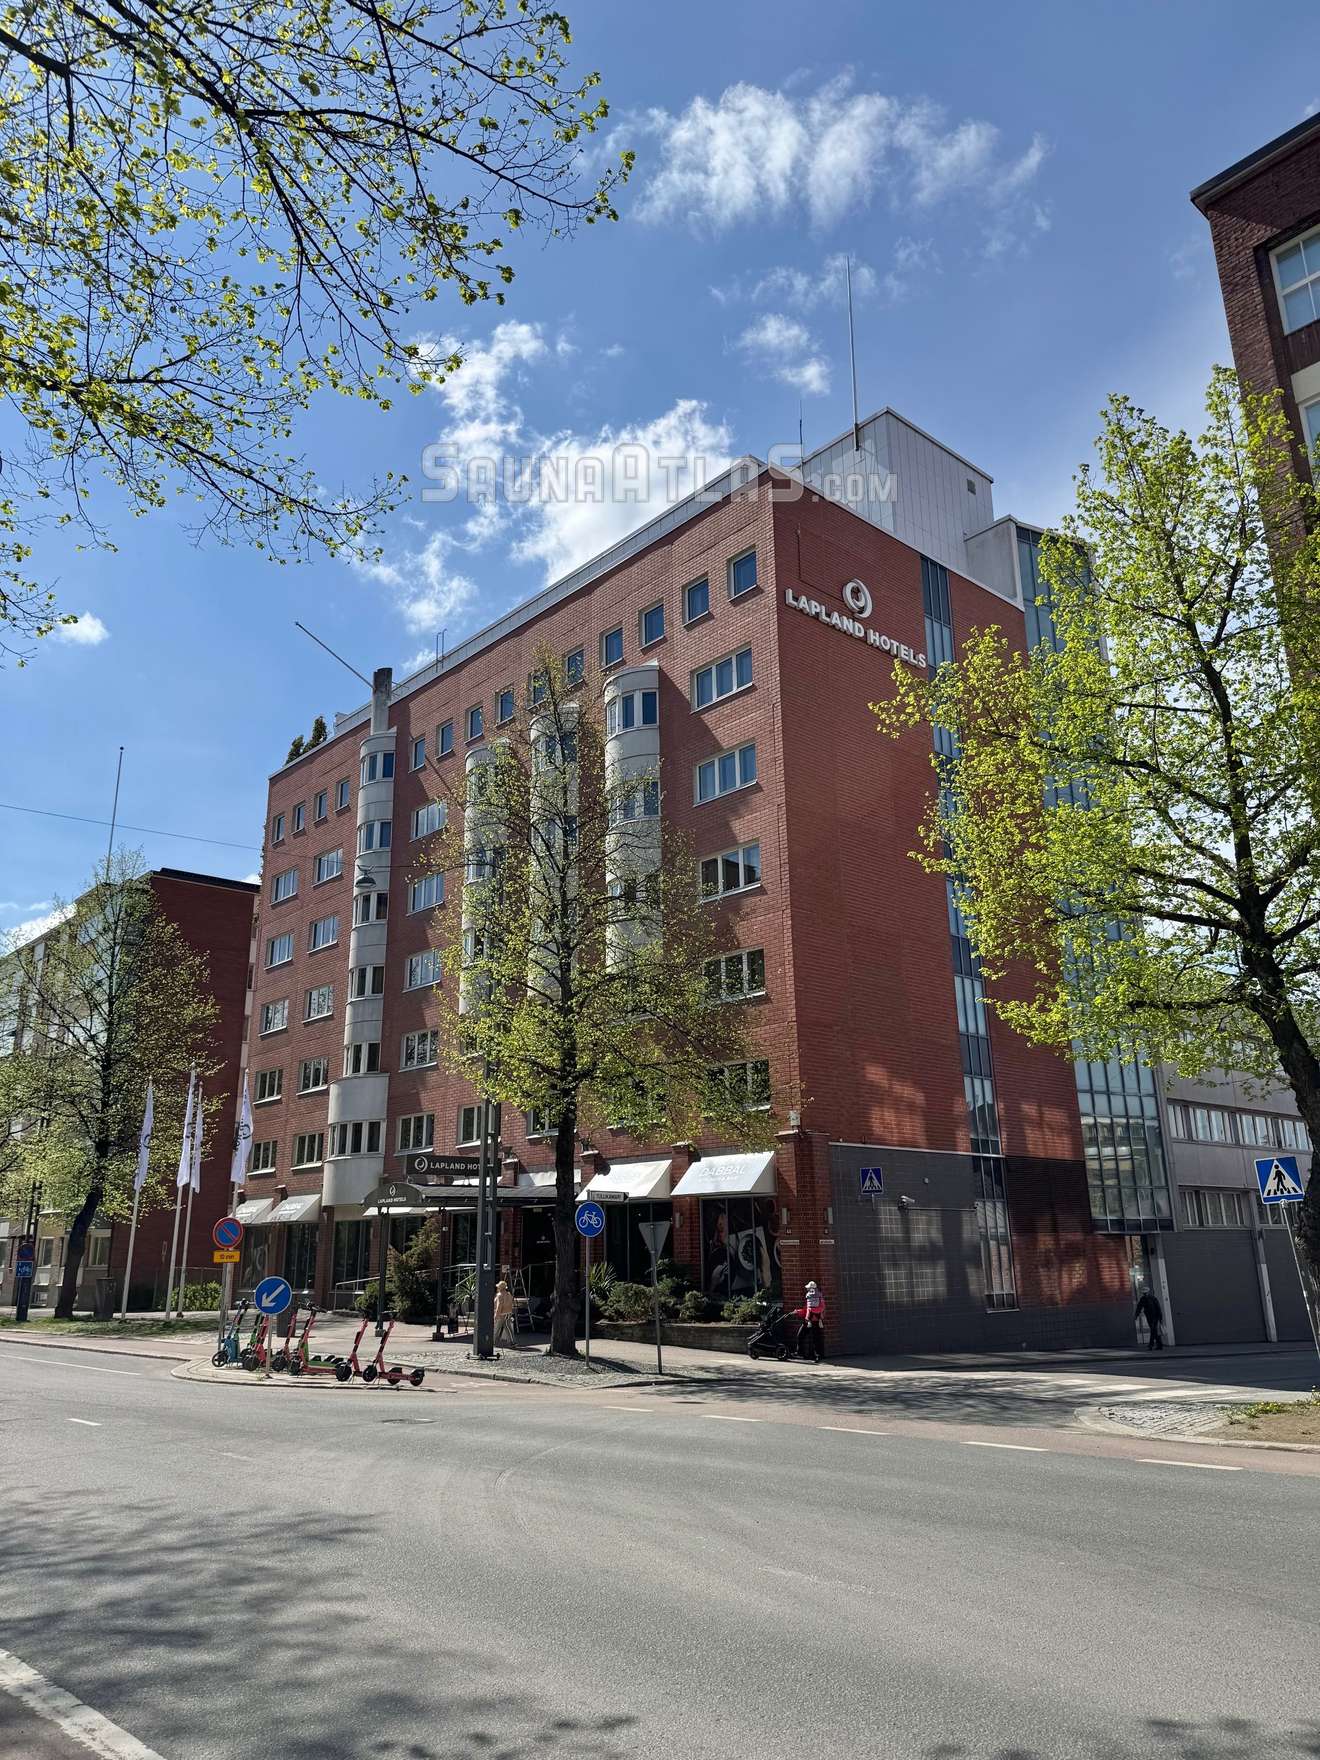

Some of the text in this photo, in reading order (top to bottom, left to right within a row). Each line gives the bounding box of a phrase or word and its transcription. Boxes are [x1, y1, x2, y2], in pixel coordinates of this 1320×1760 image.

[785, 588, 927, 668] LAPLAND HOTELS
[430, 1162, 466, 1170] LAPLAND
